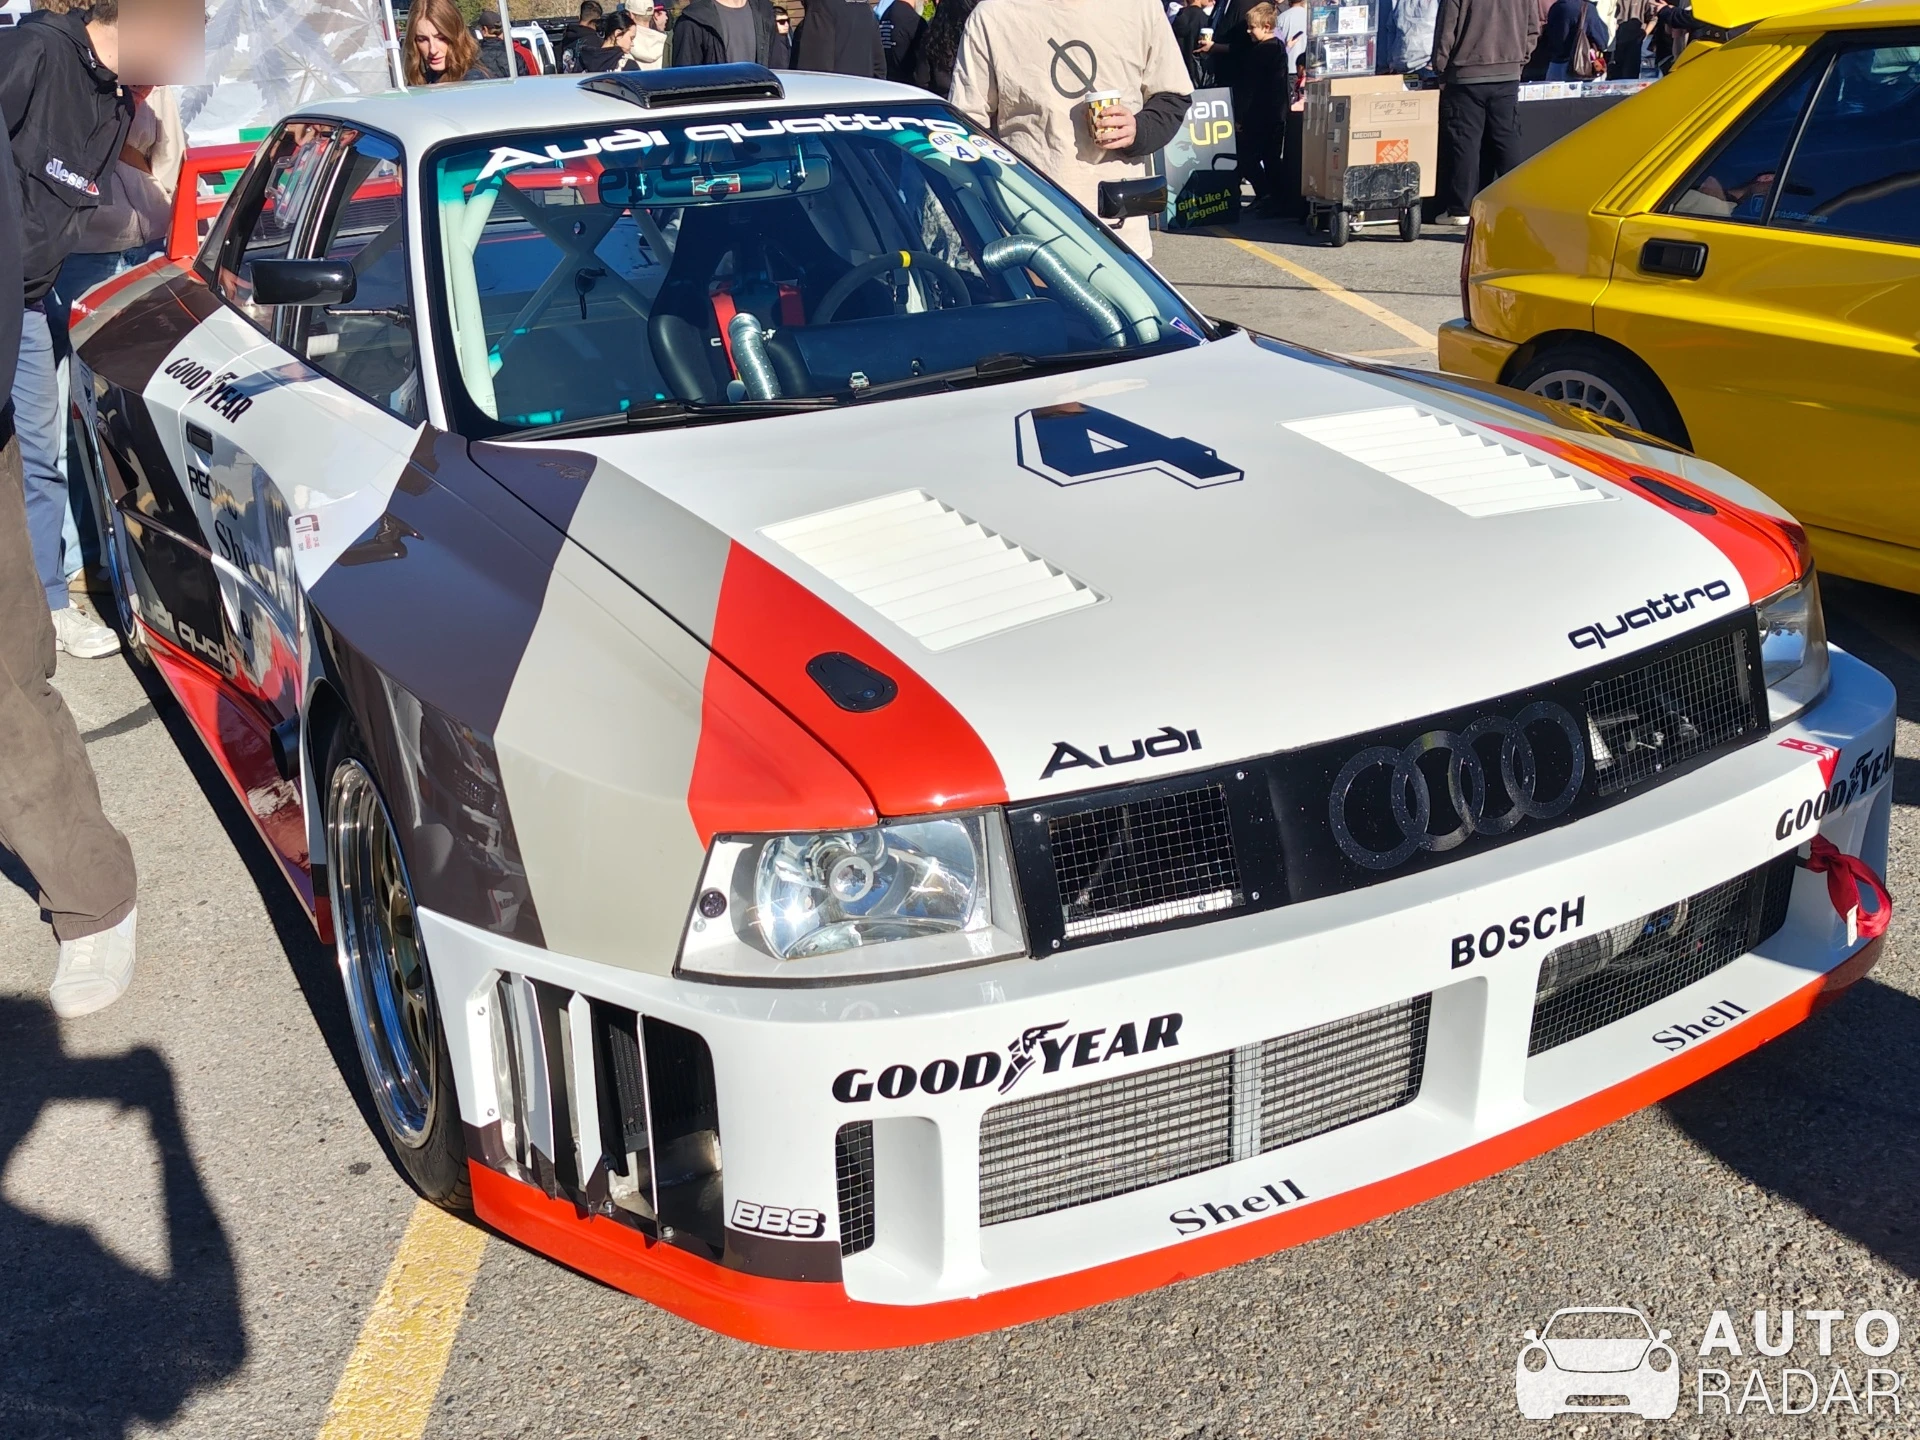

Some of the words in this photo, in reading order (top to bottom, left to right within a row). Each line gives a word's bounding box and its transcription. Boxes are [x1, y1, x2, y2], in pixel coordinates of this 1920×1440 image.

[476, 129, 669, 180] Audi
[684, 113, 967, 144] quattro
[956, 145, 975, 159] A
[992, 149, 1012, 162] C
[1353, 131, 1381, 139] MEDIUM
[1178, 196, 1197, 212] Gift
[1198, 191, 1221, 205] Like
[1223, 188, 1232, 198] A
[1186, 200, 1229, 221] Legend!
[1015, 401, 1245, 489] 4
[1568, 579, 1731, 650] quattro
[1039, 726, 1203, 781] Audi
[1451, 895, 1586, 970] BOSCH
[1652, 999, 1751, 1052] Shell
[731, 1199, 827, 1239] BBS
[1169, 1178, 1310, 1236] Shell
